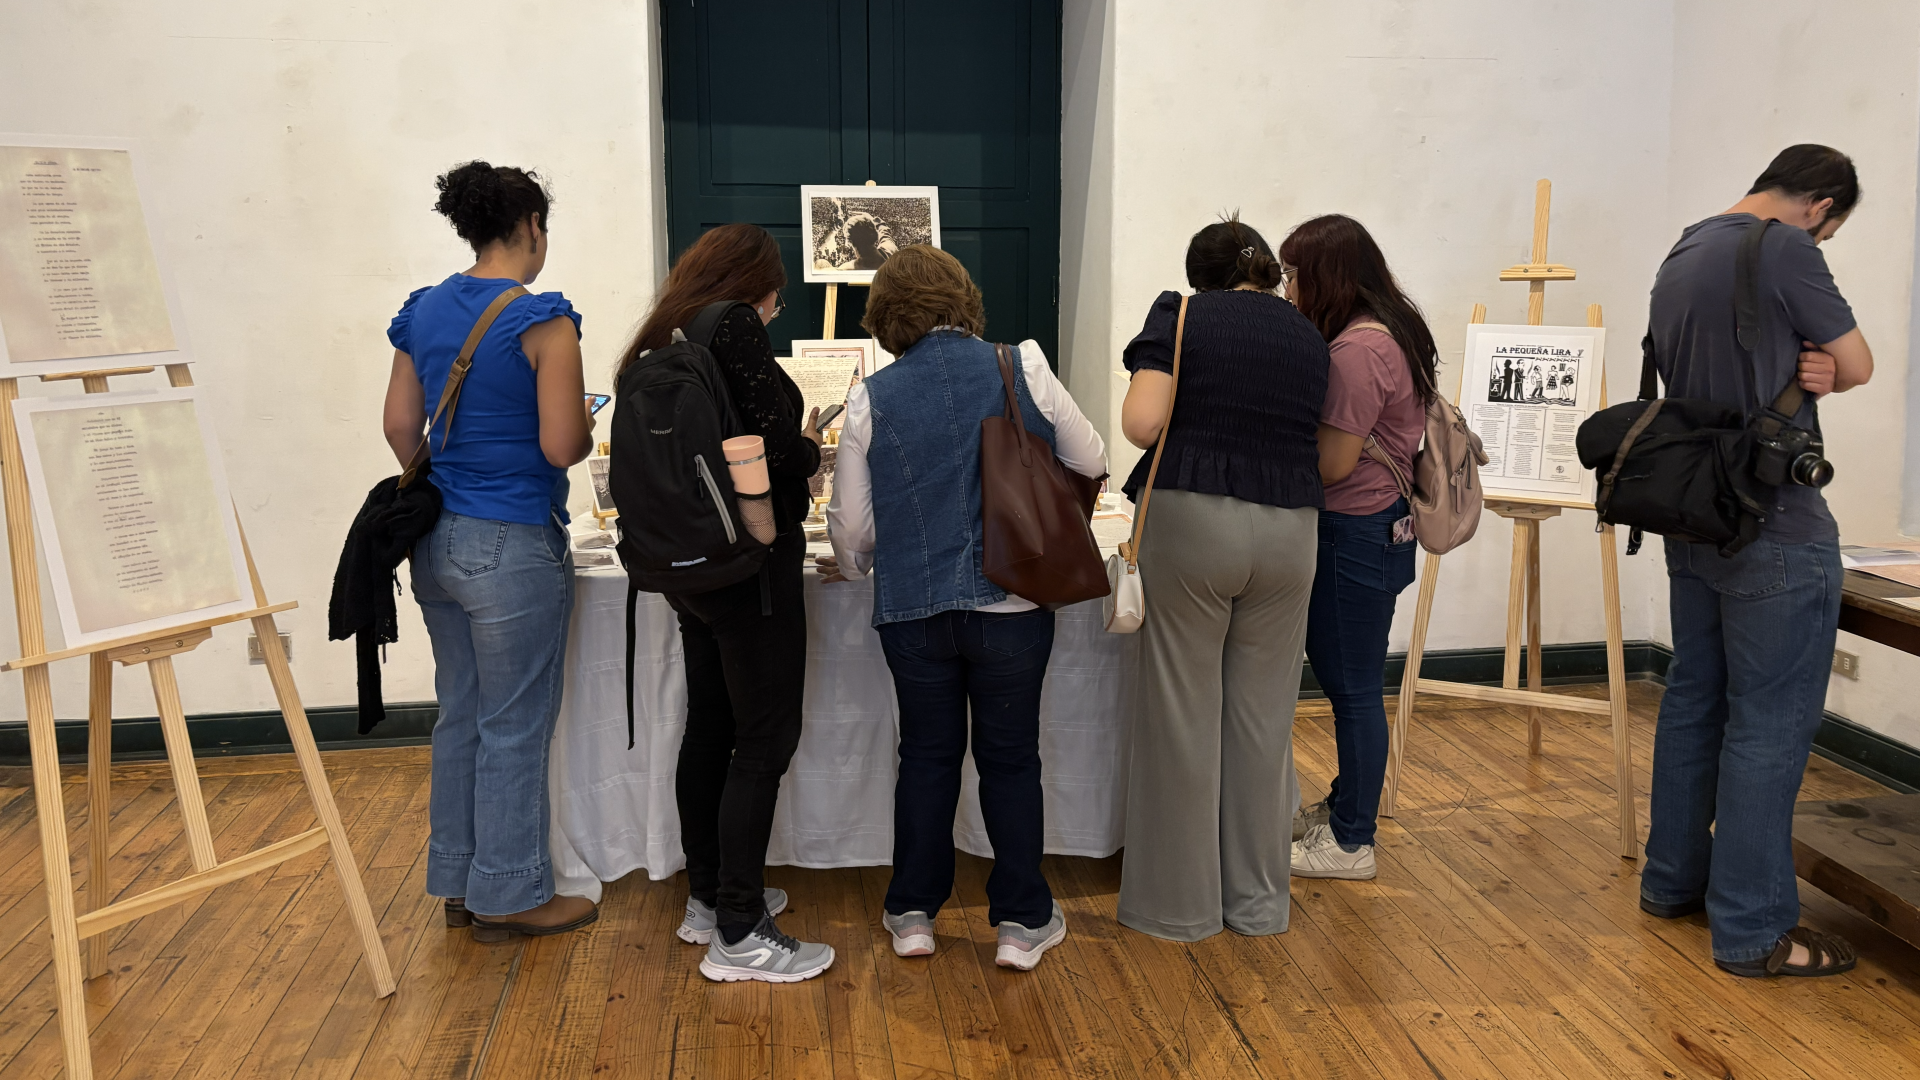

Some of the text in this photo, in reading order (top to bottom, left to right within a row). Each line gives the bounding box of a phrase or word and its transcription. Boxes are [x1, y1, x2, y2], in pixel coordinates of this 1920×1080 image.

[1496, 346, 1507, 354] LA
[1509, 346, 1549, 355] PEQUEÑA
[1551, 348, 1571, 356] LIRA
